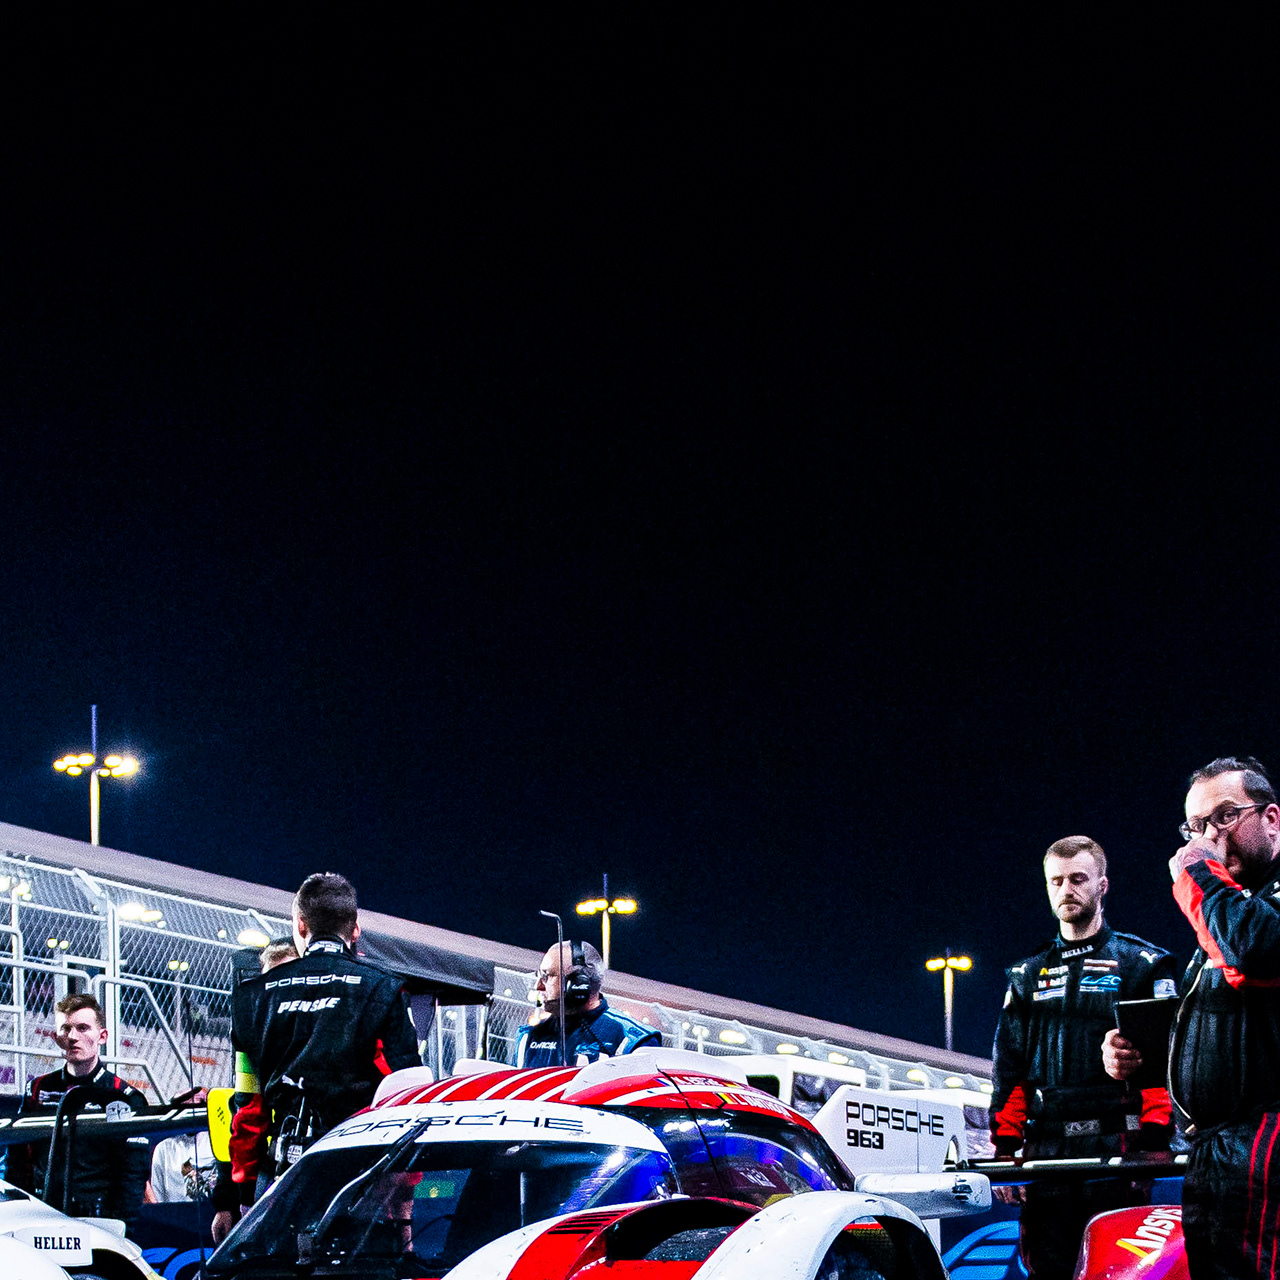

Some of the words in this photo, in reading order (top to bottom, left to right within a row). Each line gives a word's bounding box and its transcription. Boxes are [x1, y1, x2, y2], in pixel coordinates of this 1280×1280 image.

[265, 974, 362, 990] PORSCHE
[1080, 974, 1122, 985] WEC
[277, 996, 341, 1014] PENSKE
[321, 1114, 585, 1141] PORSCHE
[845, 1100, 944, 1137] PORSCHE
[846, 1128, 884, 1150] 963
[33, 1236, 82, 1250] HELLER
